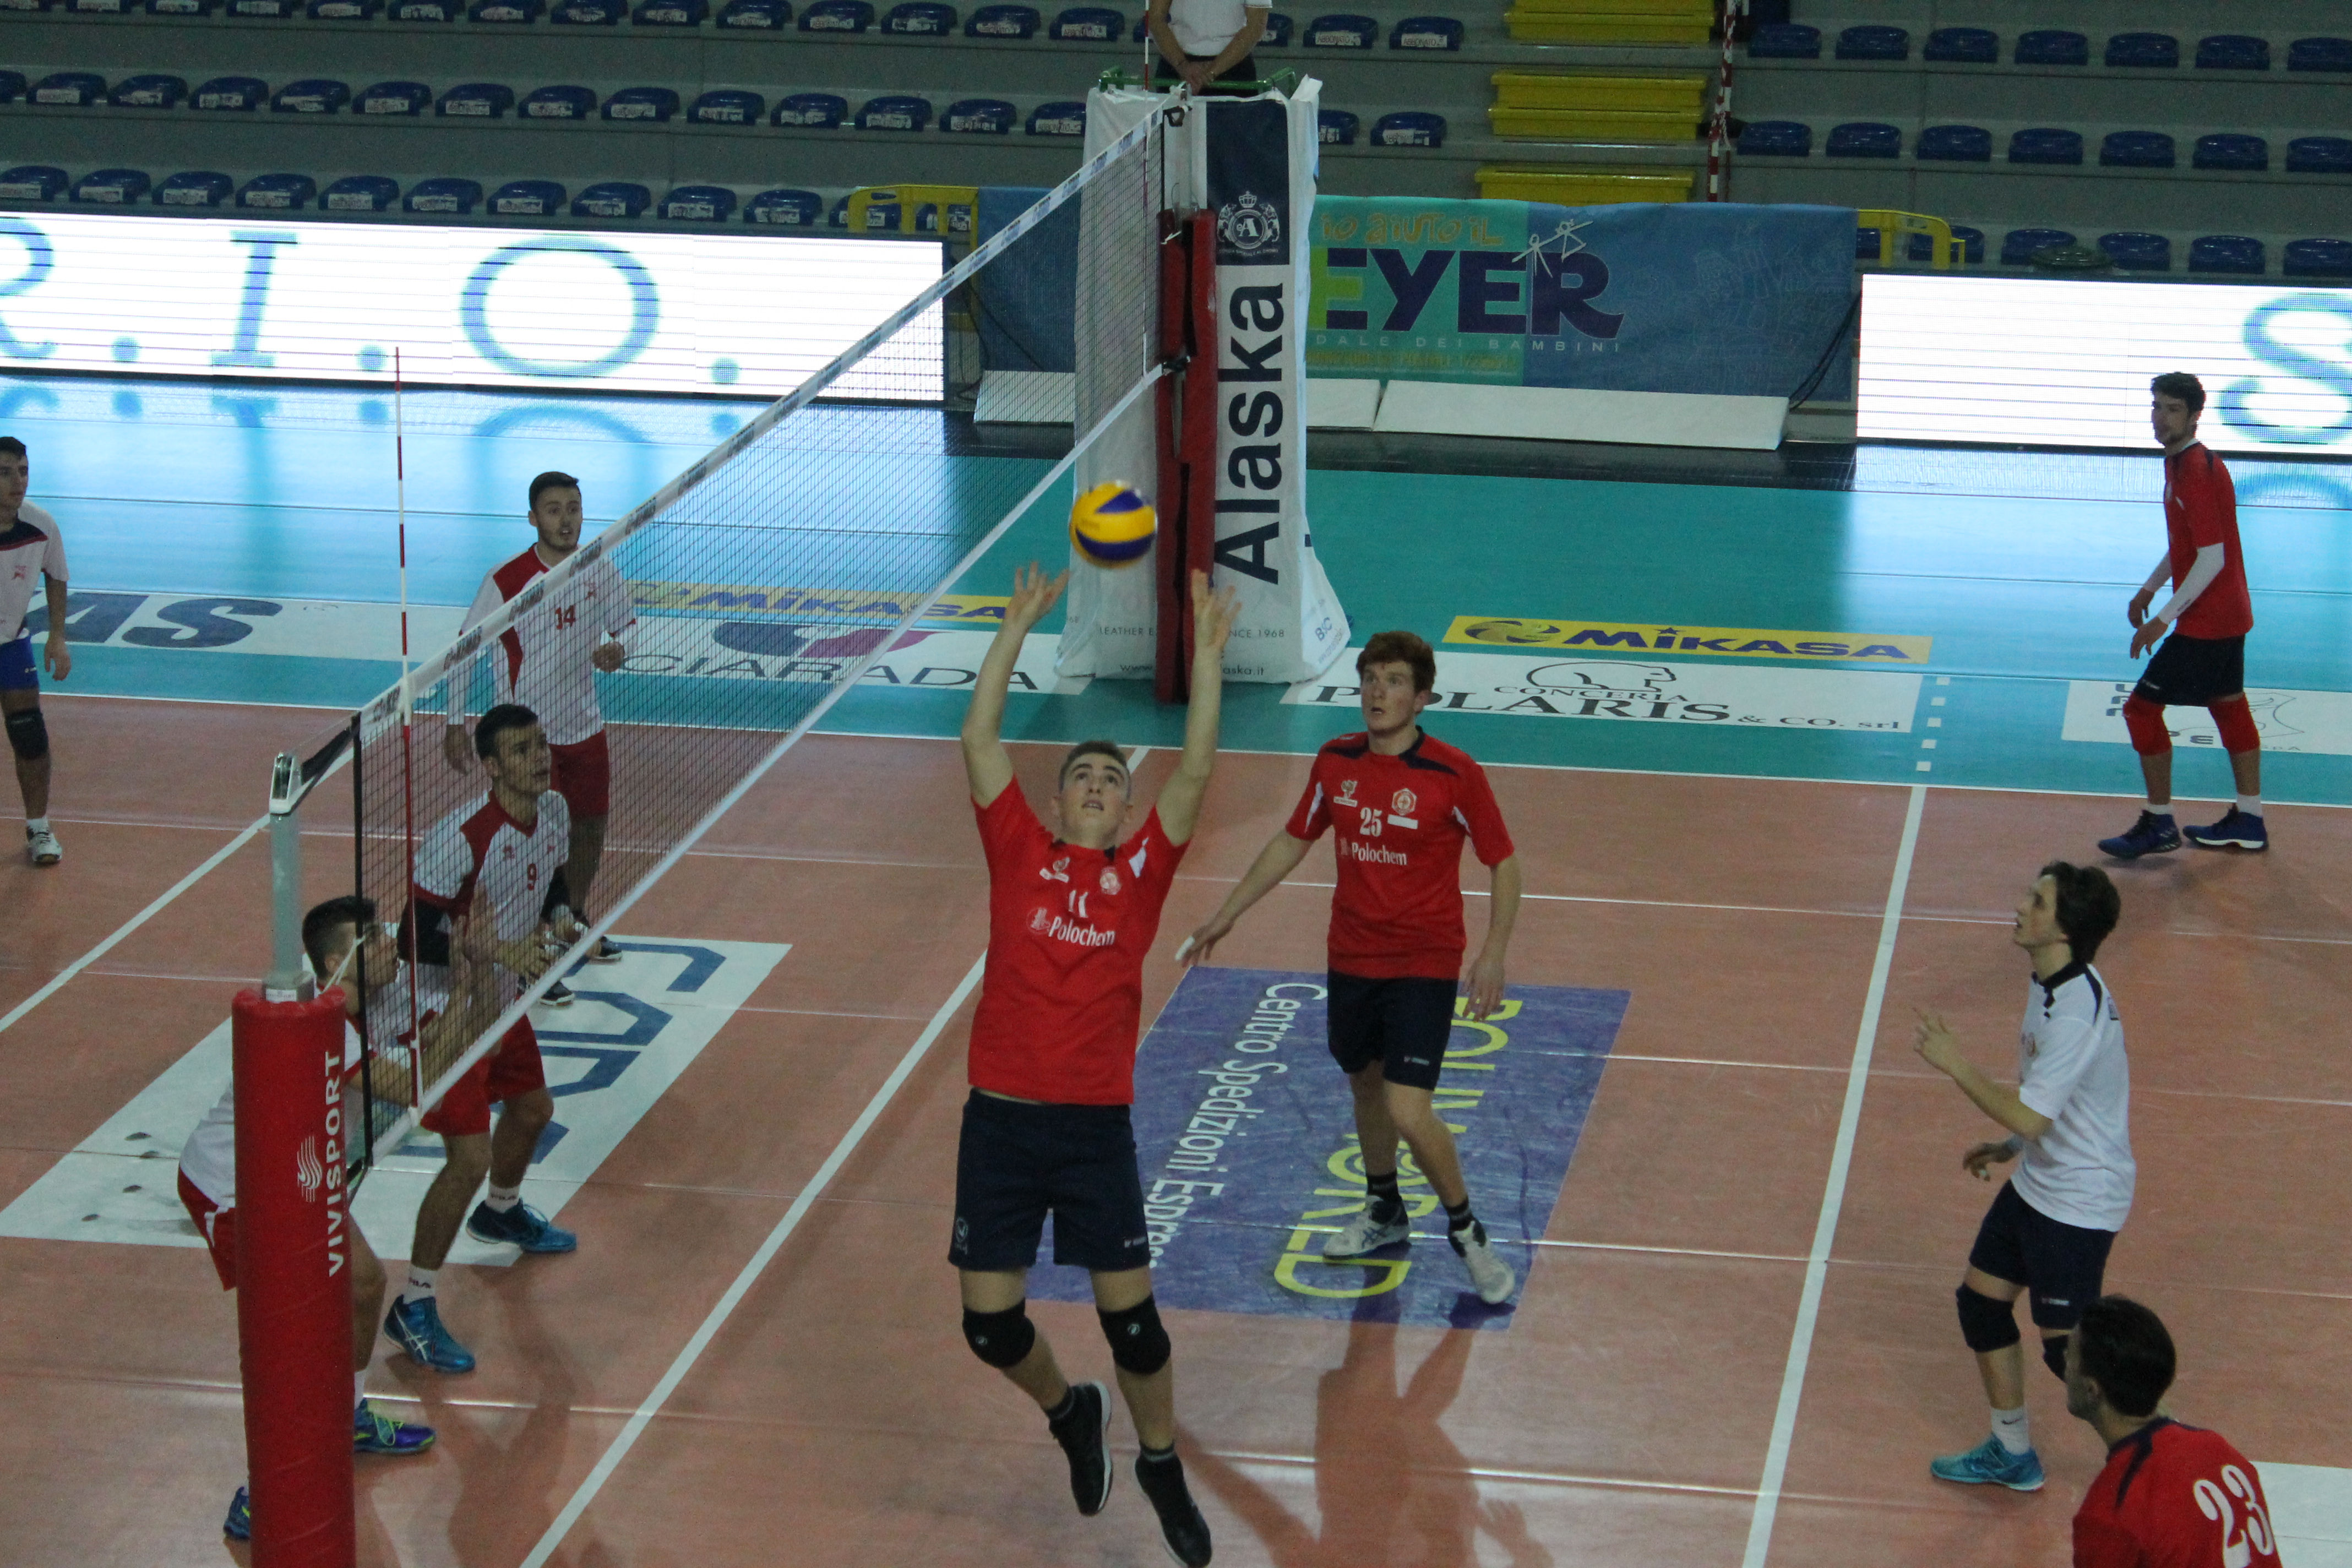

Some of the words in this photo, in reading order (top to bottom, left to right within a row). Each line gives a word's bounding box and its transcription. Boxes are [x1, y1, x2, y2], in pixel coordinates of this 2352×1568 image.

[1415, 337, 1462, 348] DEI
[1488, 339, 1620, 352] BAMBINI
[1215, 283, 1284, 584] Alaska
[554, 606, 576, 630] 14
[1099, 627, 1144, 635] LEATHER
[1228, 629, 1252, 638] NCE
[1307, 685, 1730, 722] PLARIS
[1738, 715, 1765, 723] &
[1779, 717, 1845, 727] CO.
[1494, 687, 1689, 702] CONCERIA
[1359, 807, 1383, 837] 25
[1352, 842, 1407, 866] Polochem
[527, 863, 537, 891] 9
[1048, 916, 1115, 946] Polochem
[1234, 982, 1328, 1054] Centro
[1165, 1059, 1288, 1173] Spedizioni
[324, 1050, 346, 1276] VIVISPORT
